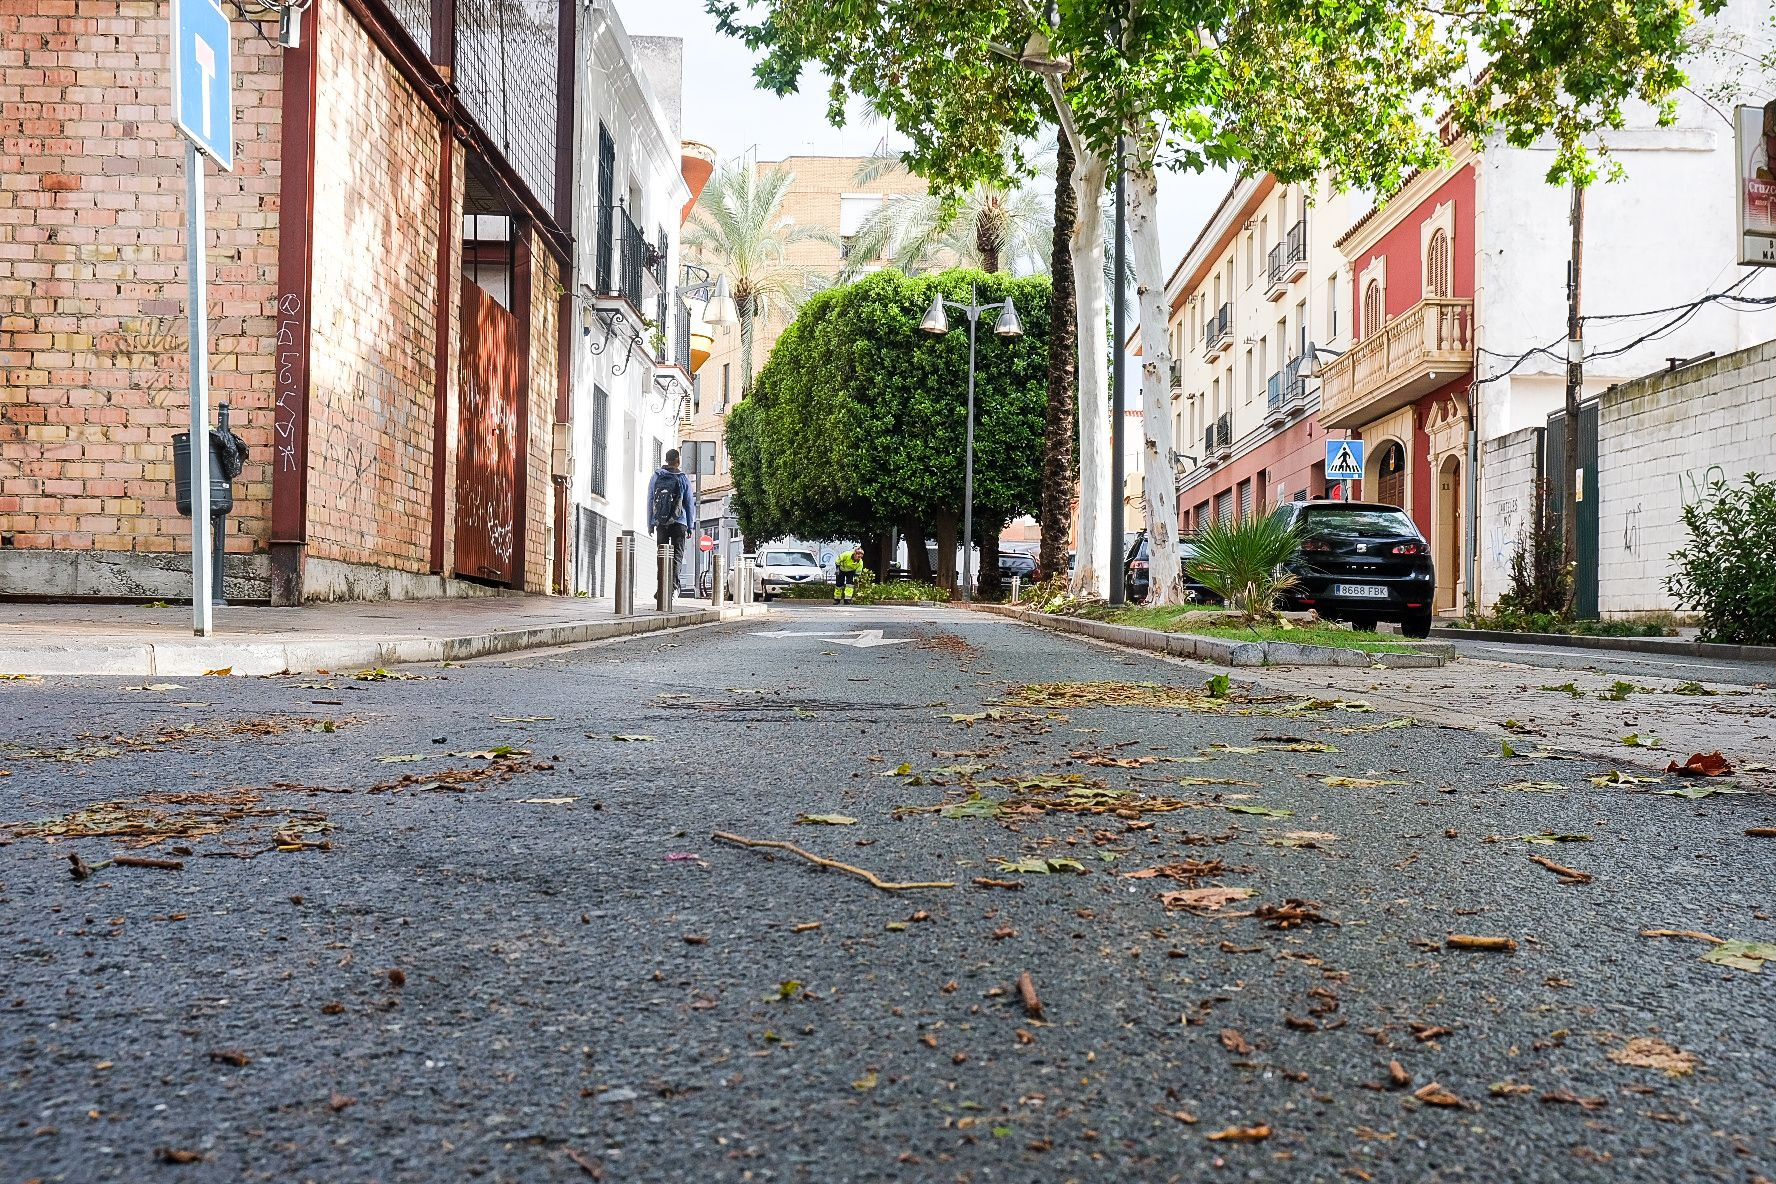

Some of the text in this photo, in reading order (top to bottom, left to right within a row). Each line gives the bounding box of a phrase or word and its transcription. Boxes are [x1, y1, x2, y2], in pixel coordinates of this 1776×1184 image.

[1441, 482, 1451, 491] 11
[1341, 585, 1386, 597] 8668 FBK
